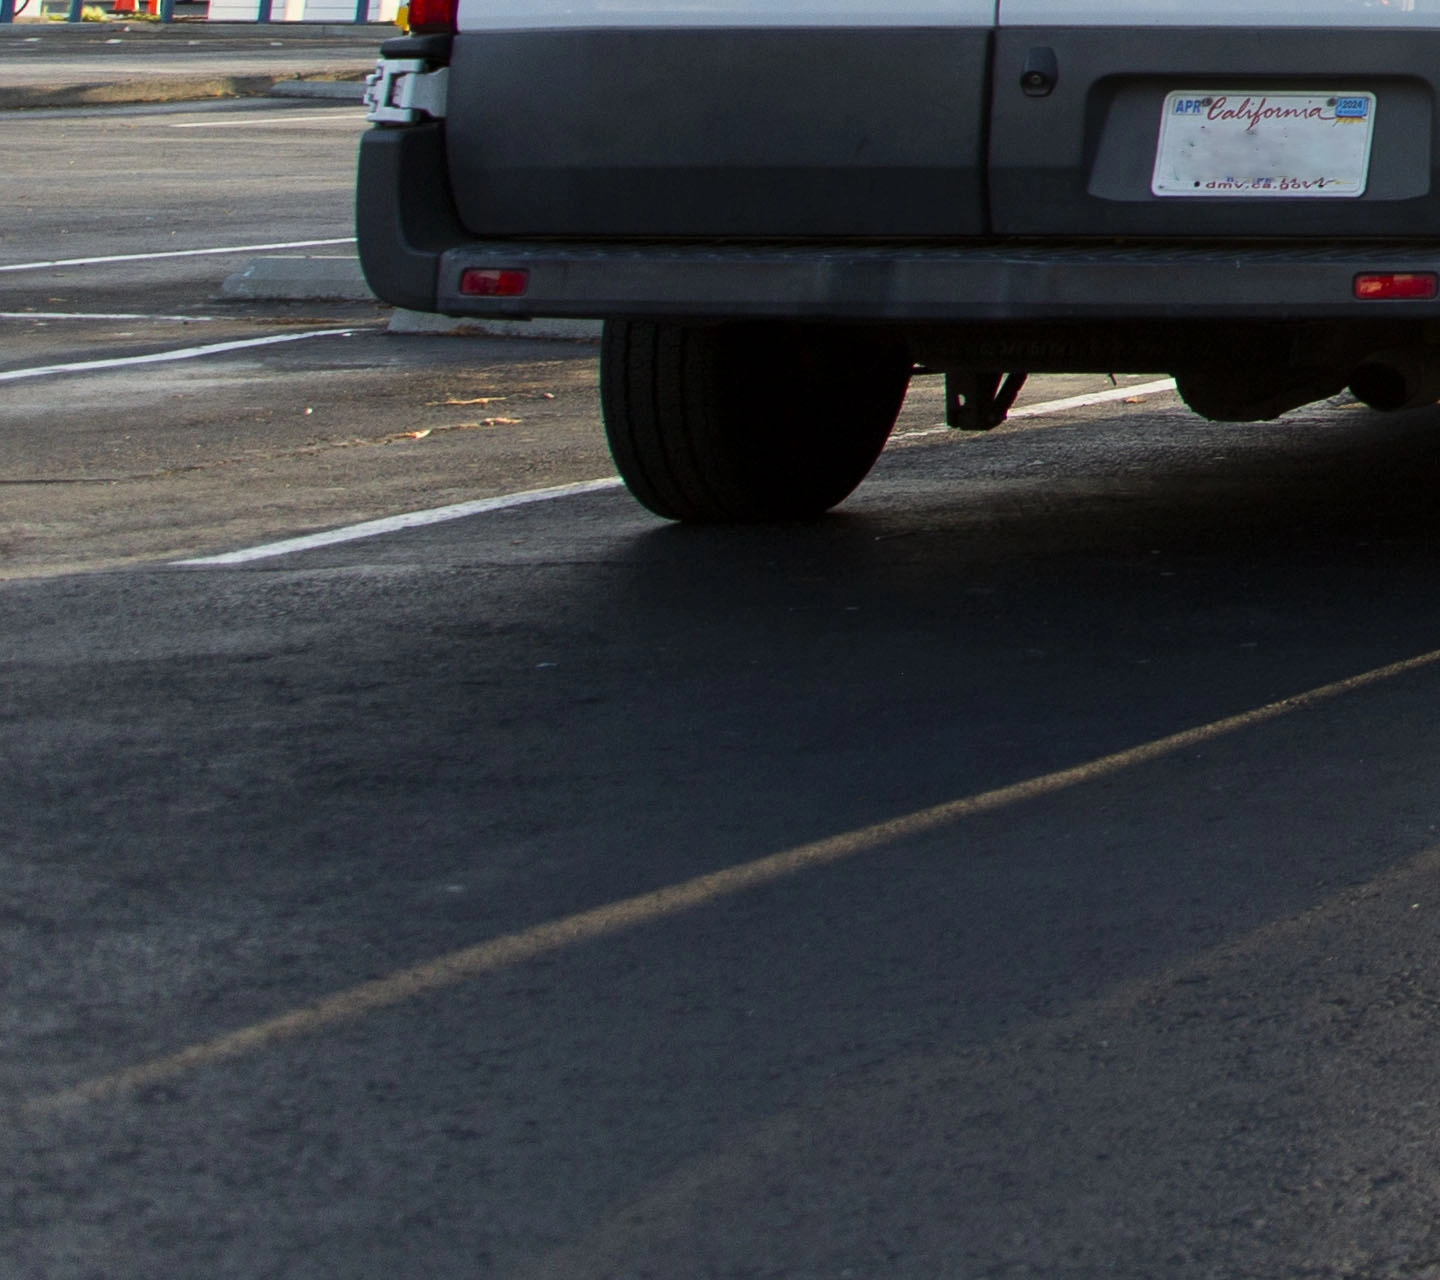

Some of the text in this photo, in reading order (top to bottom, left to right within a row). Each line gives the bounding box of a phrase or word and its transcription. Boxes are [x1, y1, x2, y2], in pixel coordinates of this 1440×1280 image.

[1175, 100, 1202, 114] APR
[1342, 99, 1363, 110] 2024
[1206, 96, 1337, 131] California
